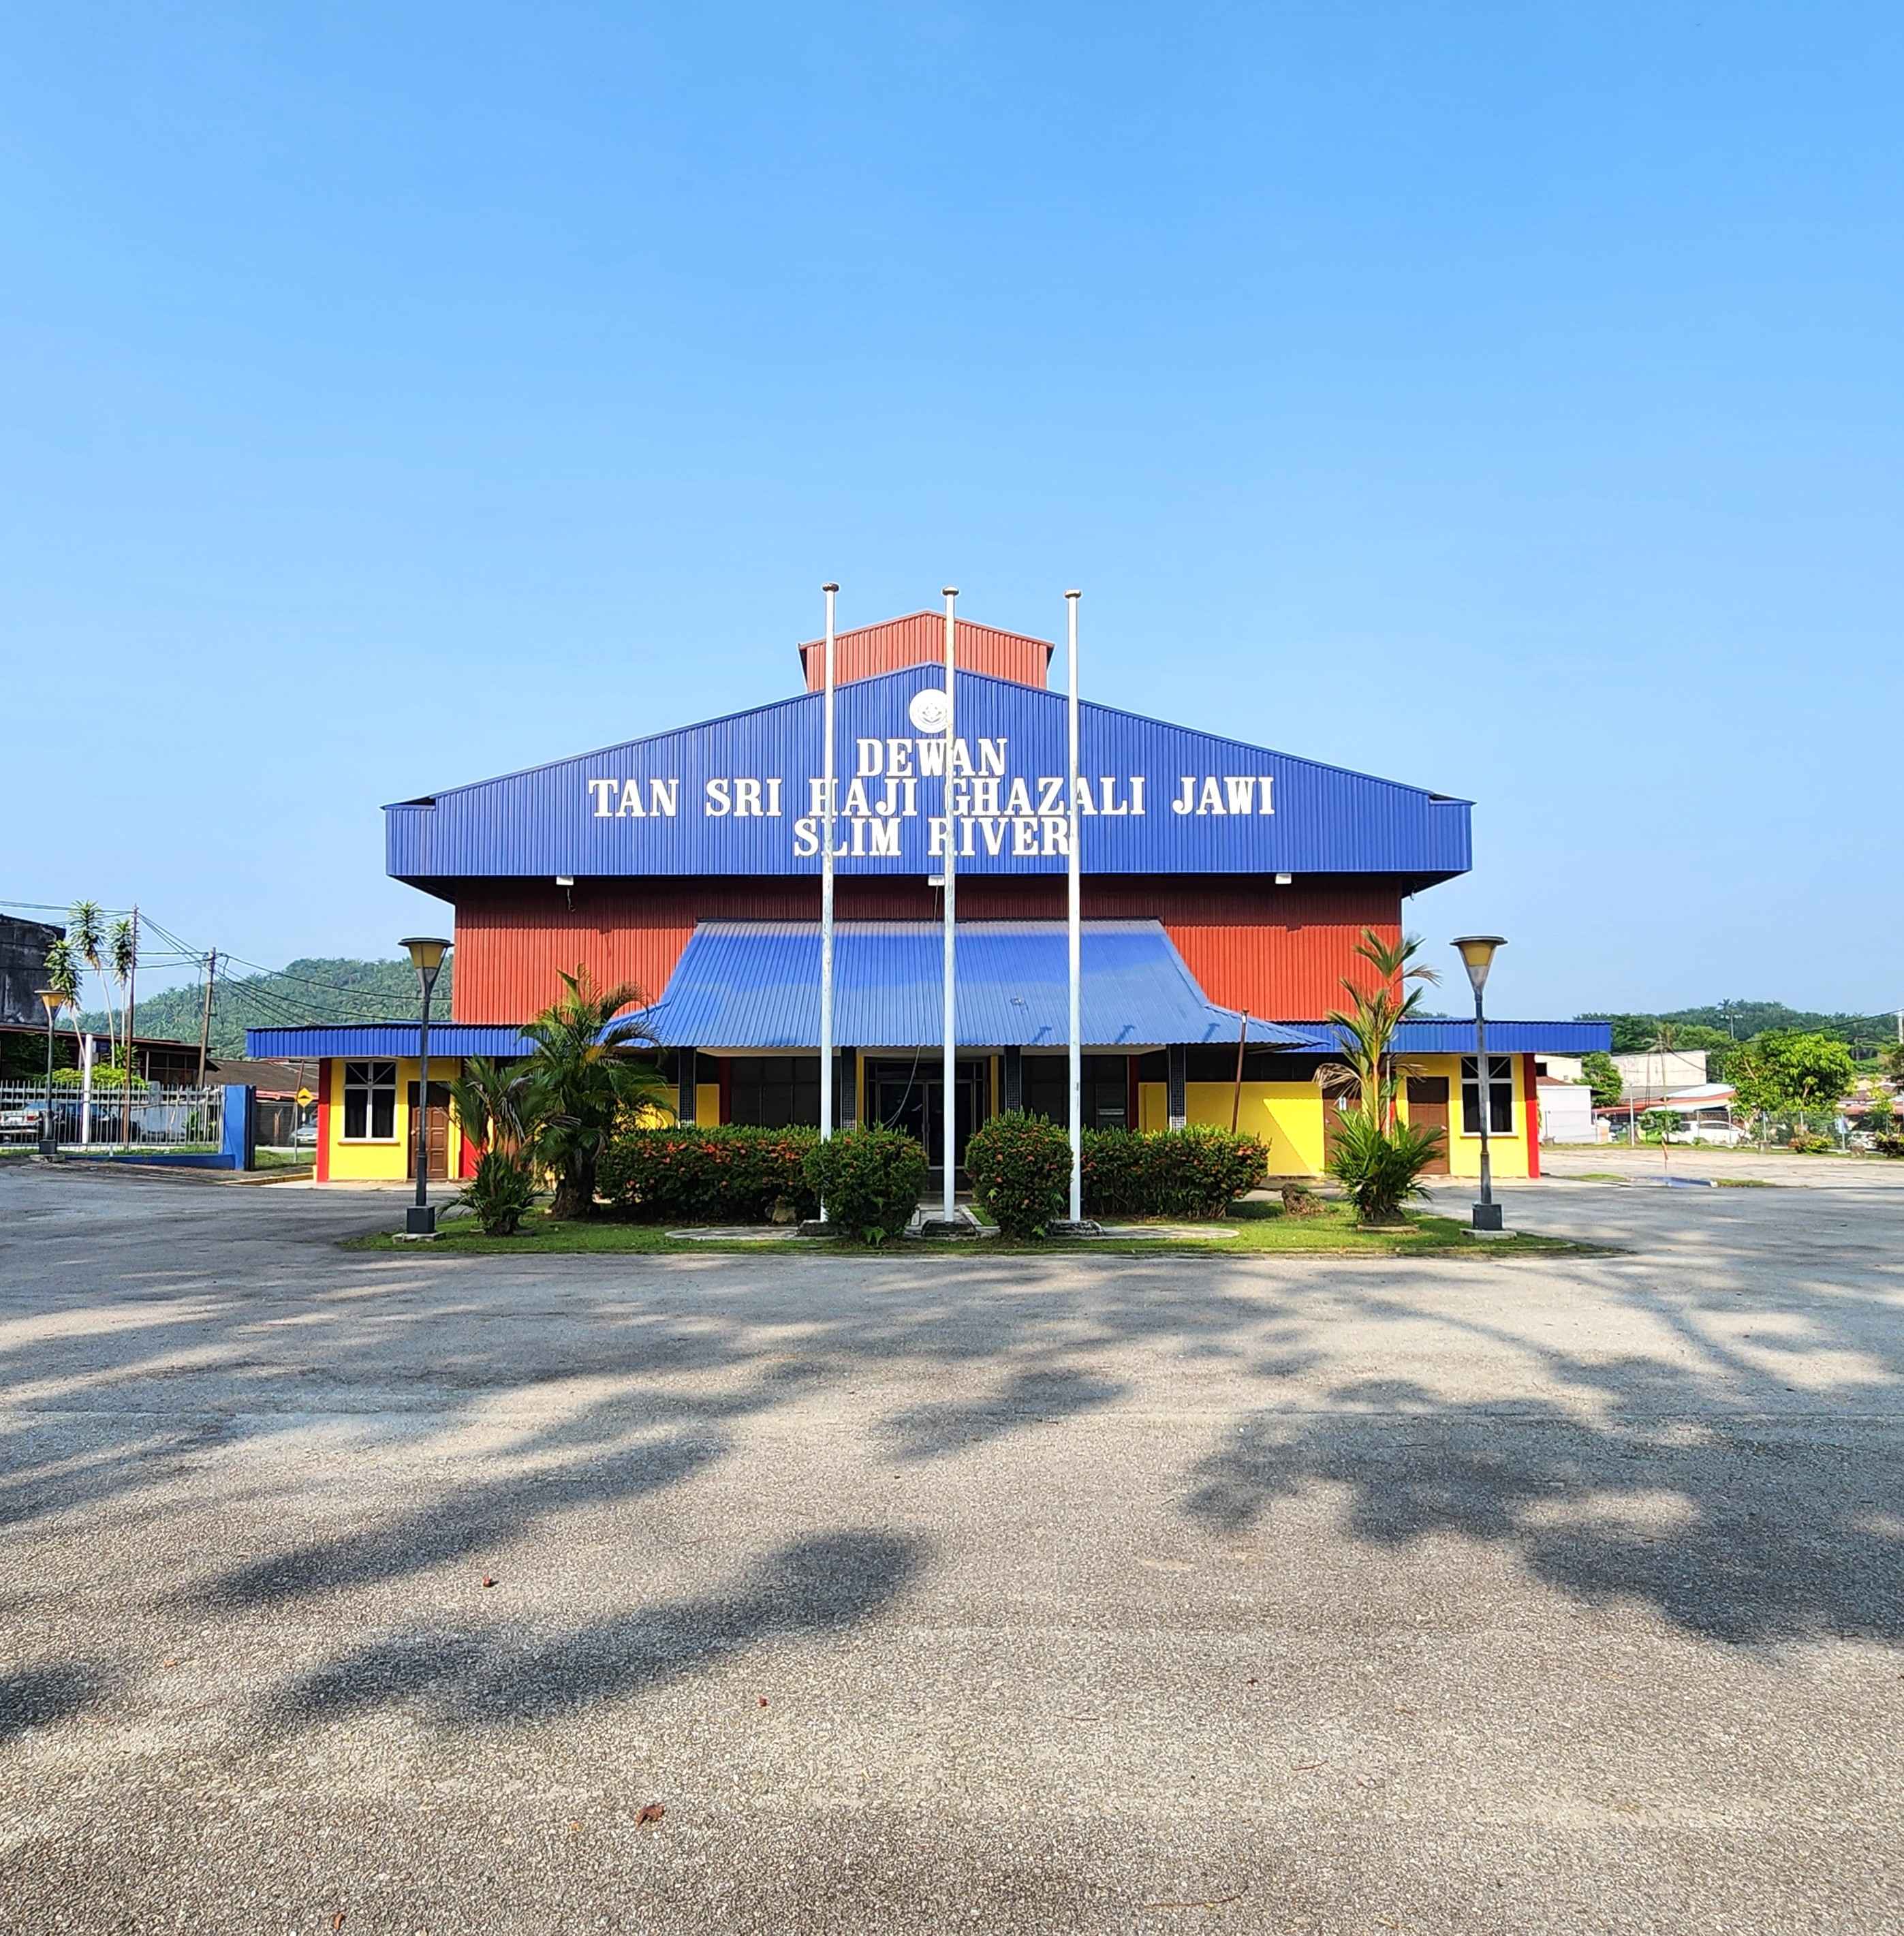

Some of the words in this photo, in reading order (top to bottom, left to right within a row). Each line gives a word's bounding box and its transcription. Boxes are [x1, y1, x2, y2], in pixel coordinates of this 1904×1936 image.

[856, 738, 1008, 777] DEWAN
[588, 779, 679, 817] TAN
[706, 779, 782, 817] SRI
[809, 778, 918, 816] HAJI
[945, 777, 1146, 816] GHAZALI
[1172, 777, 1275, 815] JAWI
[927, 817, 1072, 856] RIVER
